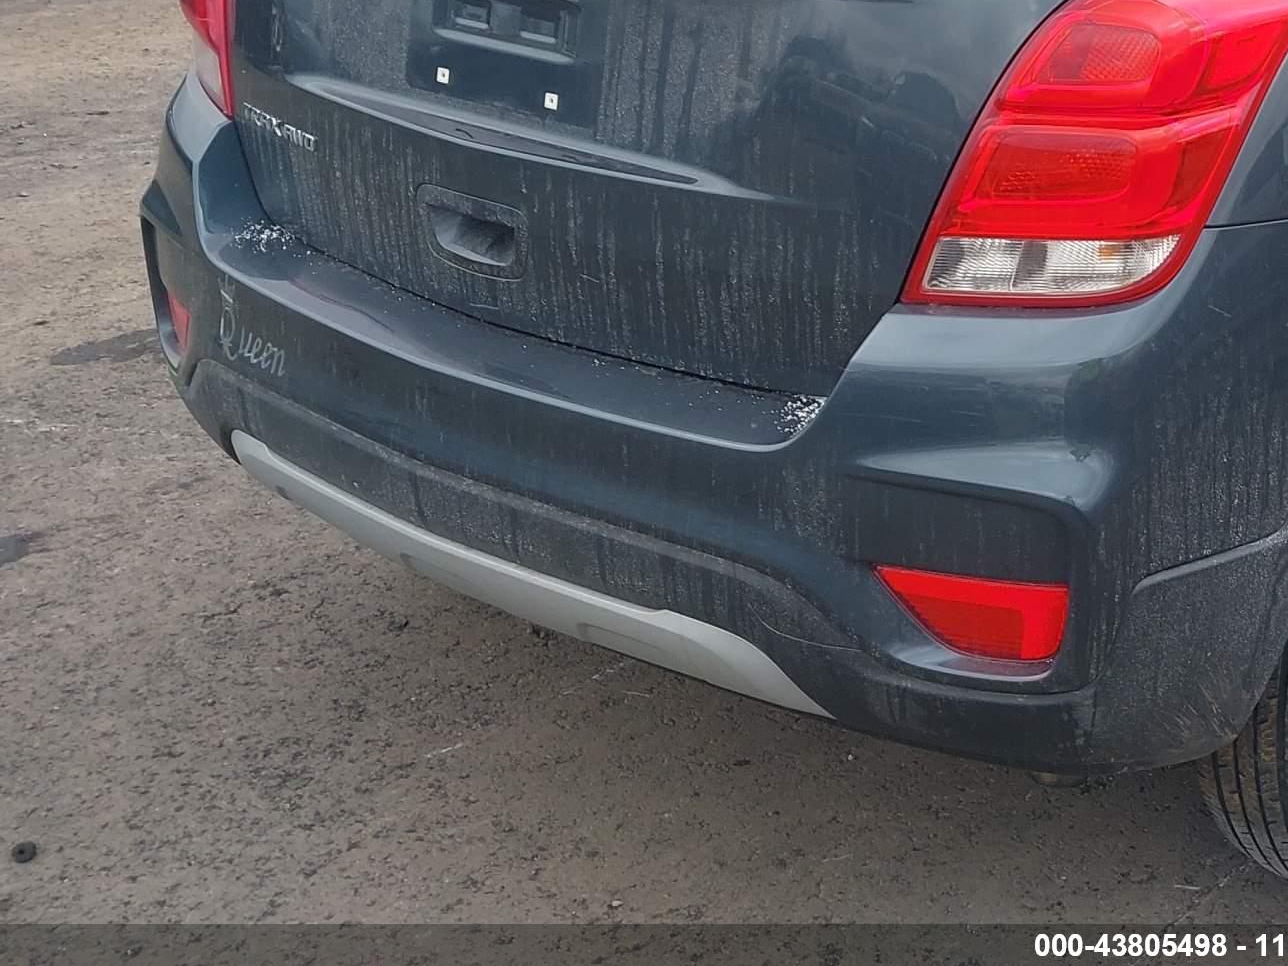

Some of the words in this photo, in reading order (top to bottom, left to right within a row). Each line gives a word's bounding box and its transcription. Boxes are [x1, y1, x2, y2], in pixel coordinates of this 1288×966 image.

[242, 101, 282, 137] TRAX
[282, 123, 316, 152] AWD
[218, 306, 286, 378] Queen
